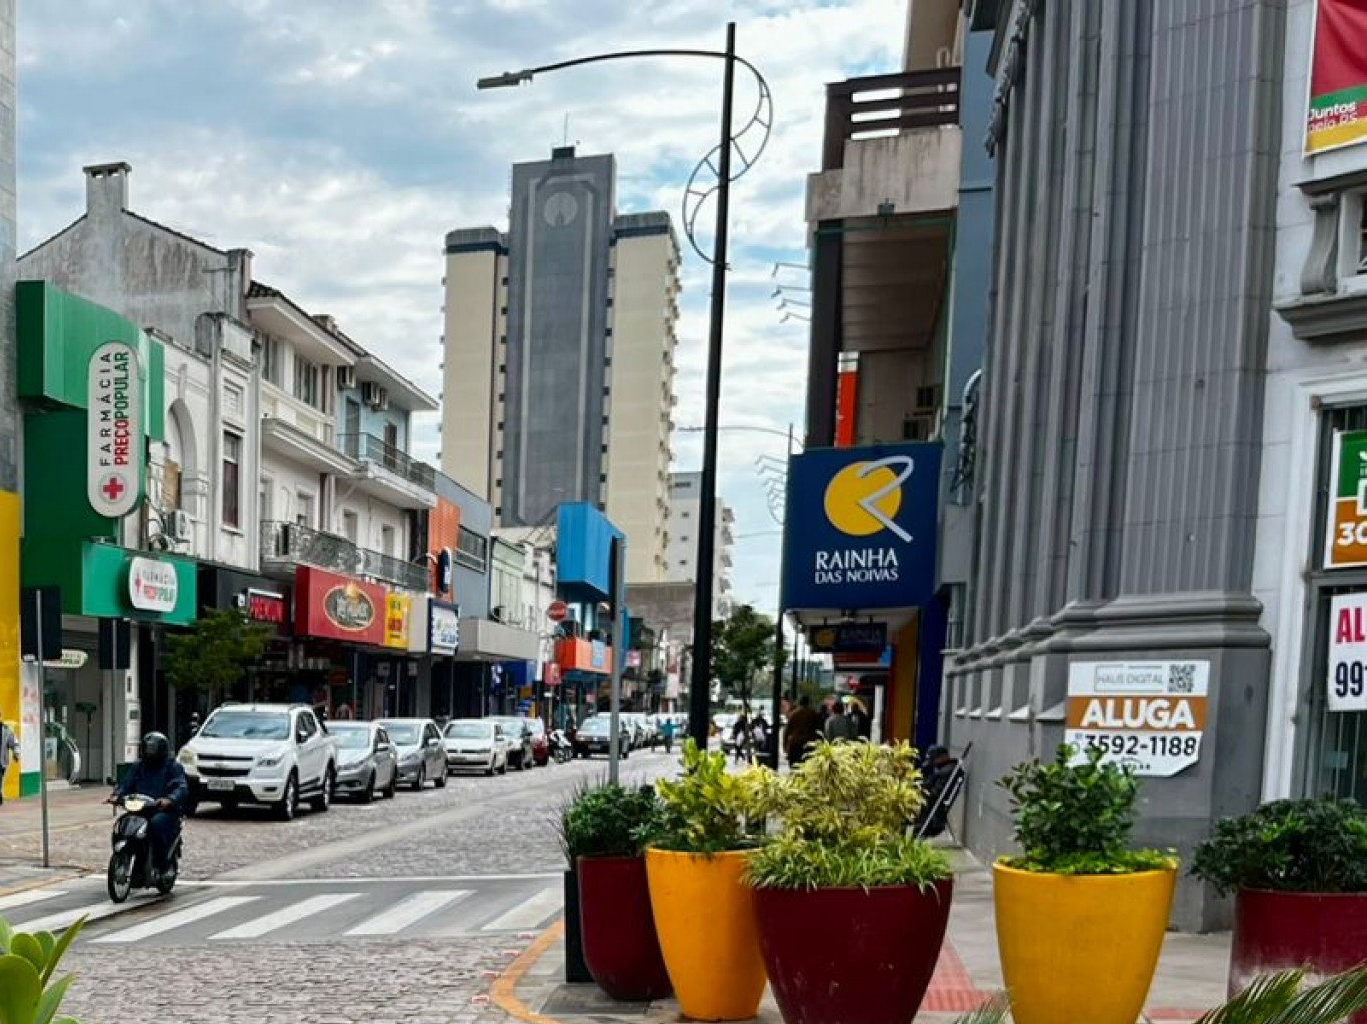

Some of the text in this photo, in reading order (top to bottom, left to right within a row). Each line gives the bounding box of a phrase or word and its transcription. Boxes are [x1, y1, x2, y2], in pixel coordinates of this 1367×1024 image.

[1309, 102, 1356, 119] Juntos
[97, 353, 112, 467] FARMÁCIA
[815, 548, 898, 569] RAINHA
[815, 568, 898, 584] DAS NOIVAS
[1080, 697, 1196, 729] ALUGA
[1084, 735, 1197, 757] 3592-1188
